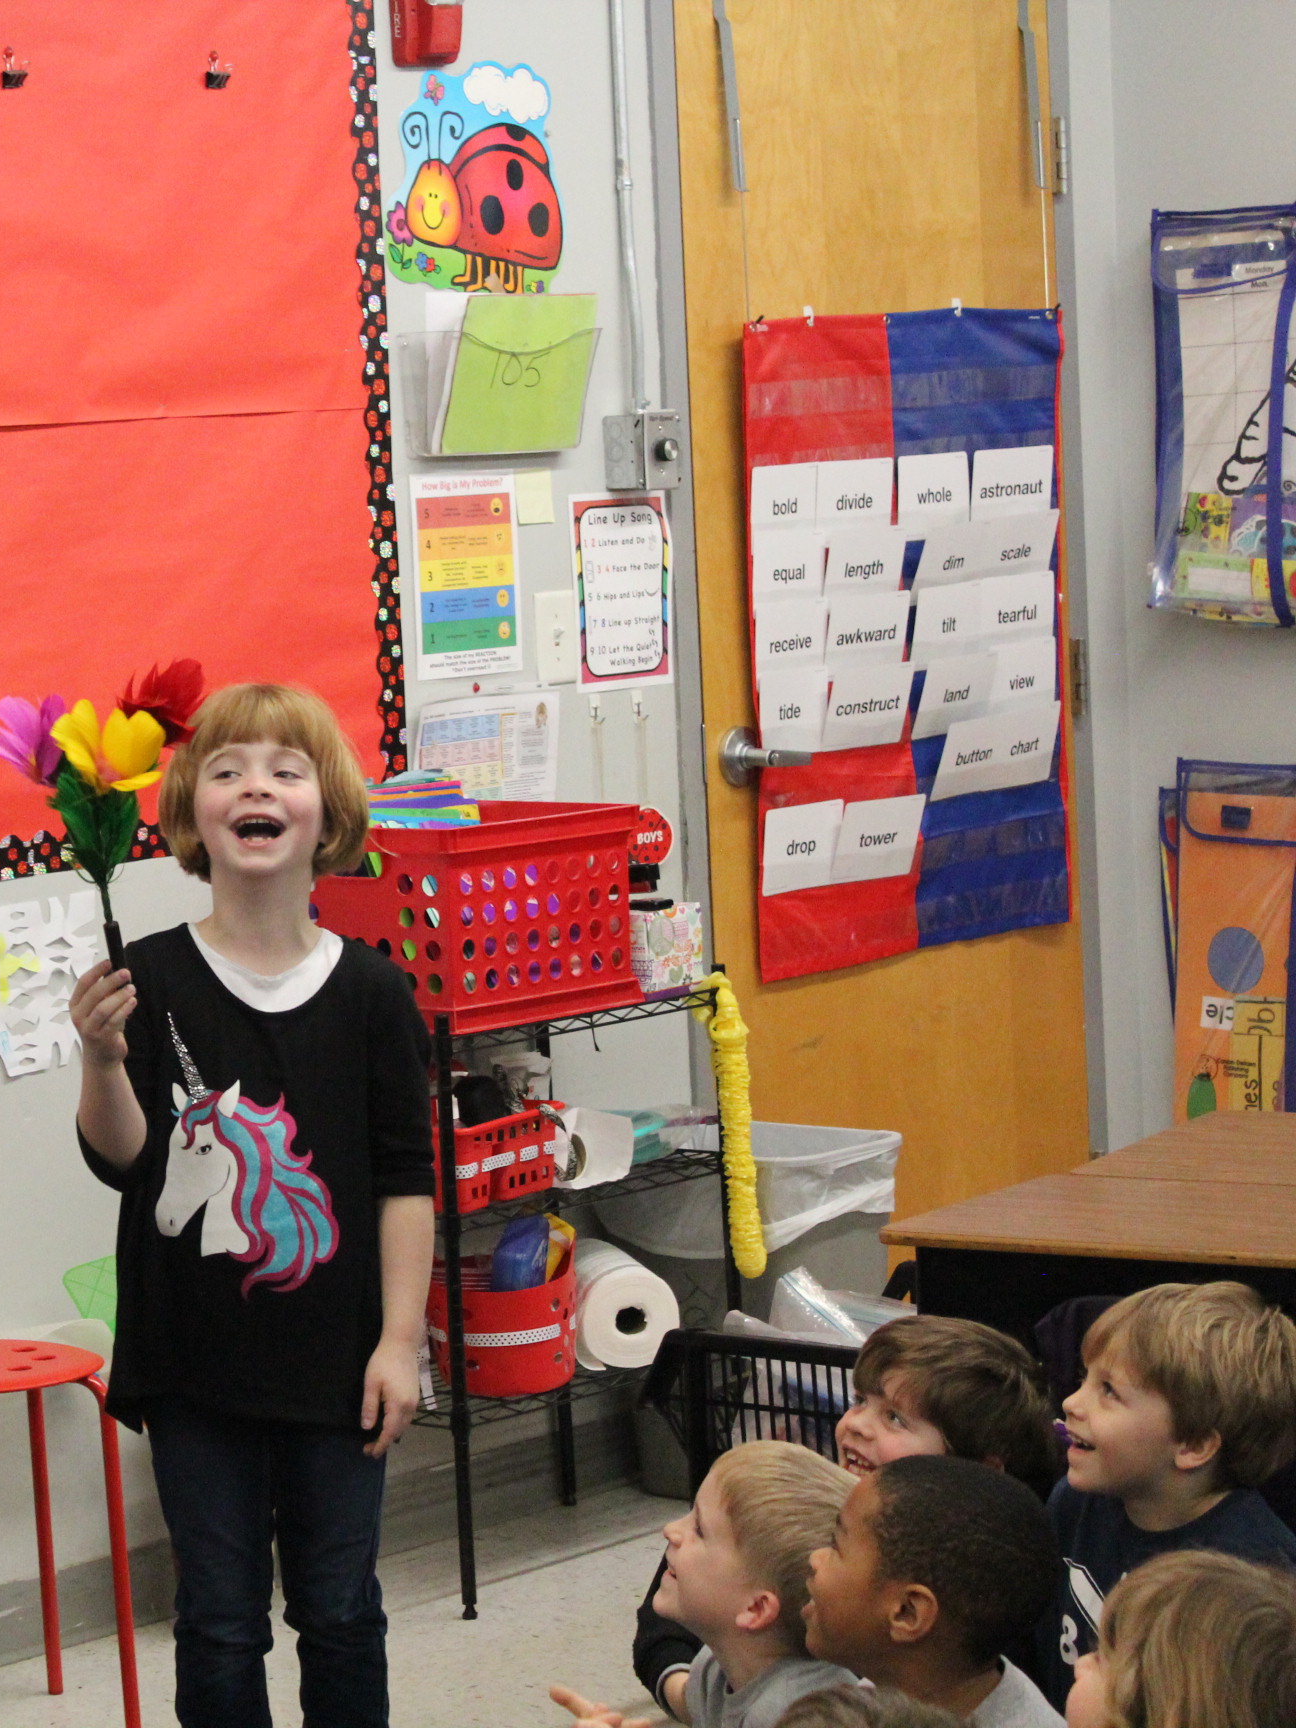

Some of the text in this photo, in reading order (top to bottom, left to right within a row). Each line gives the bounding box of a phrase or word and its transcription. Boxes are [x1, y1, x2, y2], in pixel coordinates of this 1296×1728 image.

[422, 482, 438, 491] How
[440, 480, 451, 492] Big
[459, 480, 470, 490] My
[472, 477, 503, 488] Problem?
[772, 479, 1044, 516] bold divide whole astronaut
[424, 508, 430, 519] 5
[588, 512, 652, 526] Line Up Song
[426, 539, 431, 550] 4
[591, 538, 596, 547] 2
[598, 539, 619, 547] Listen
[622, 537, 634, 545] and
[597, 565, 602, 574] 3
[605, 564, 610, 572] 4
[612, 564, 627, 572] Face
[644, 562, 660, 570] Door
[773, 544, 1032, 585] equal length dim scale
[427, 571, 433, 582] 3
[588, 591, 644, 602] 5 6 Hips and Lips
[429, 602, 435, 613] 2
[593, 619, 597, 628] 7
[601, 618, 606, 627] 8
[609, 618, 621, 627] Line
[634, 615, 660, 625] Straight
[769, 604, 1037, 654] receive awkward tilt tearful
[430, 634, 436, 645] 1
[590, 646, 594, 655] 9
[598, 645, 606, 655] 10
[609, 646, 619, 654] Let
[636, 643, 652, 652] Quiet
[609, 655, 653, 666] Walking Begin
[779, 674, 1035, 721] tide construct land view
[955, 737, 1040, 767] button chart
[637, 830, 664, 845] BOYS
[786, 831, 898, 857] drop tower
